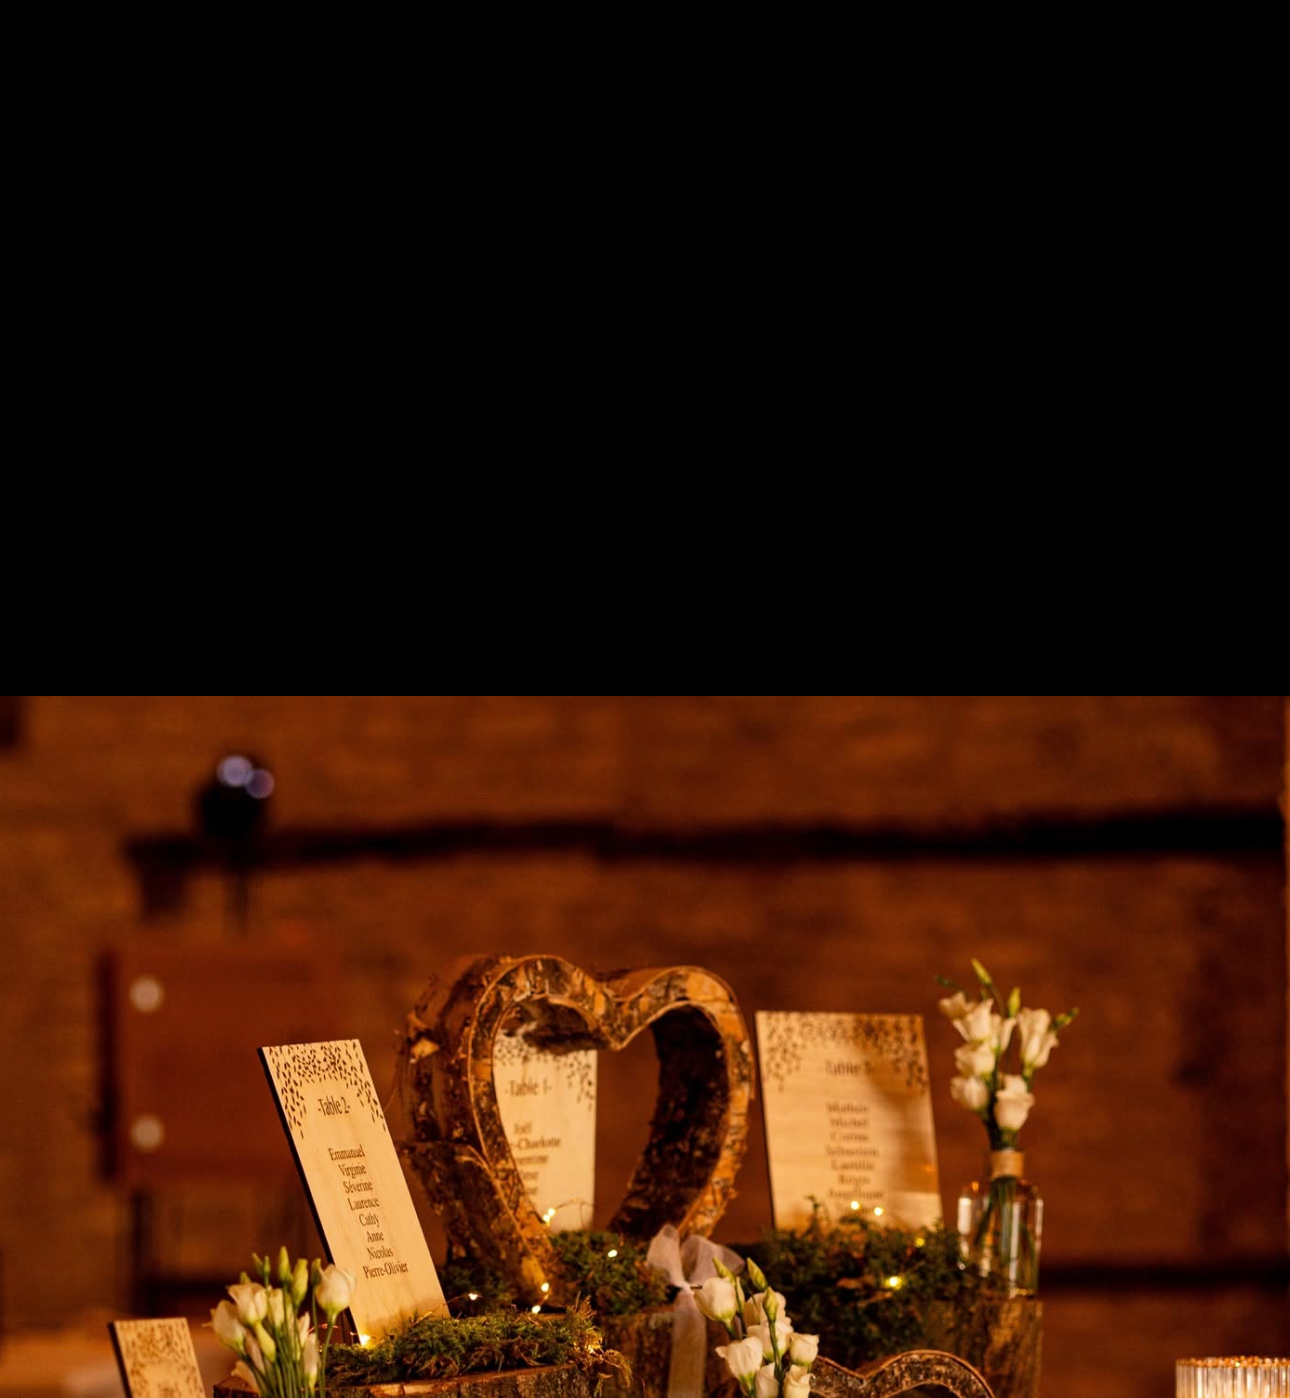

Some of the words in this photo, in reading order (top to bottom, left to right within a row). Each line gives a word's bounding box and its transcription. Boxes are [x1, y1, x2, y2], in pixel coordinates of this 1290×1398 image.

[328, 1144, 366, 1161] Emmanuel
[338, 1164, 366, 1178] Virginie
[343, 1180, 373, 1194] Séverine
[348, 1196, 379, 1211] Laurence
[359, 1213, 380, 1227] Cathy
[367, 1231, 384, 1243] Anne
[367, 1246, 394, 1260] Nicolas
[363, 1261, 409, 1279] Pierre-Olivier
